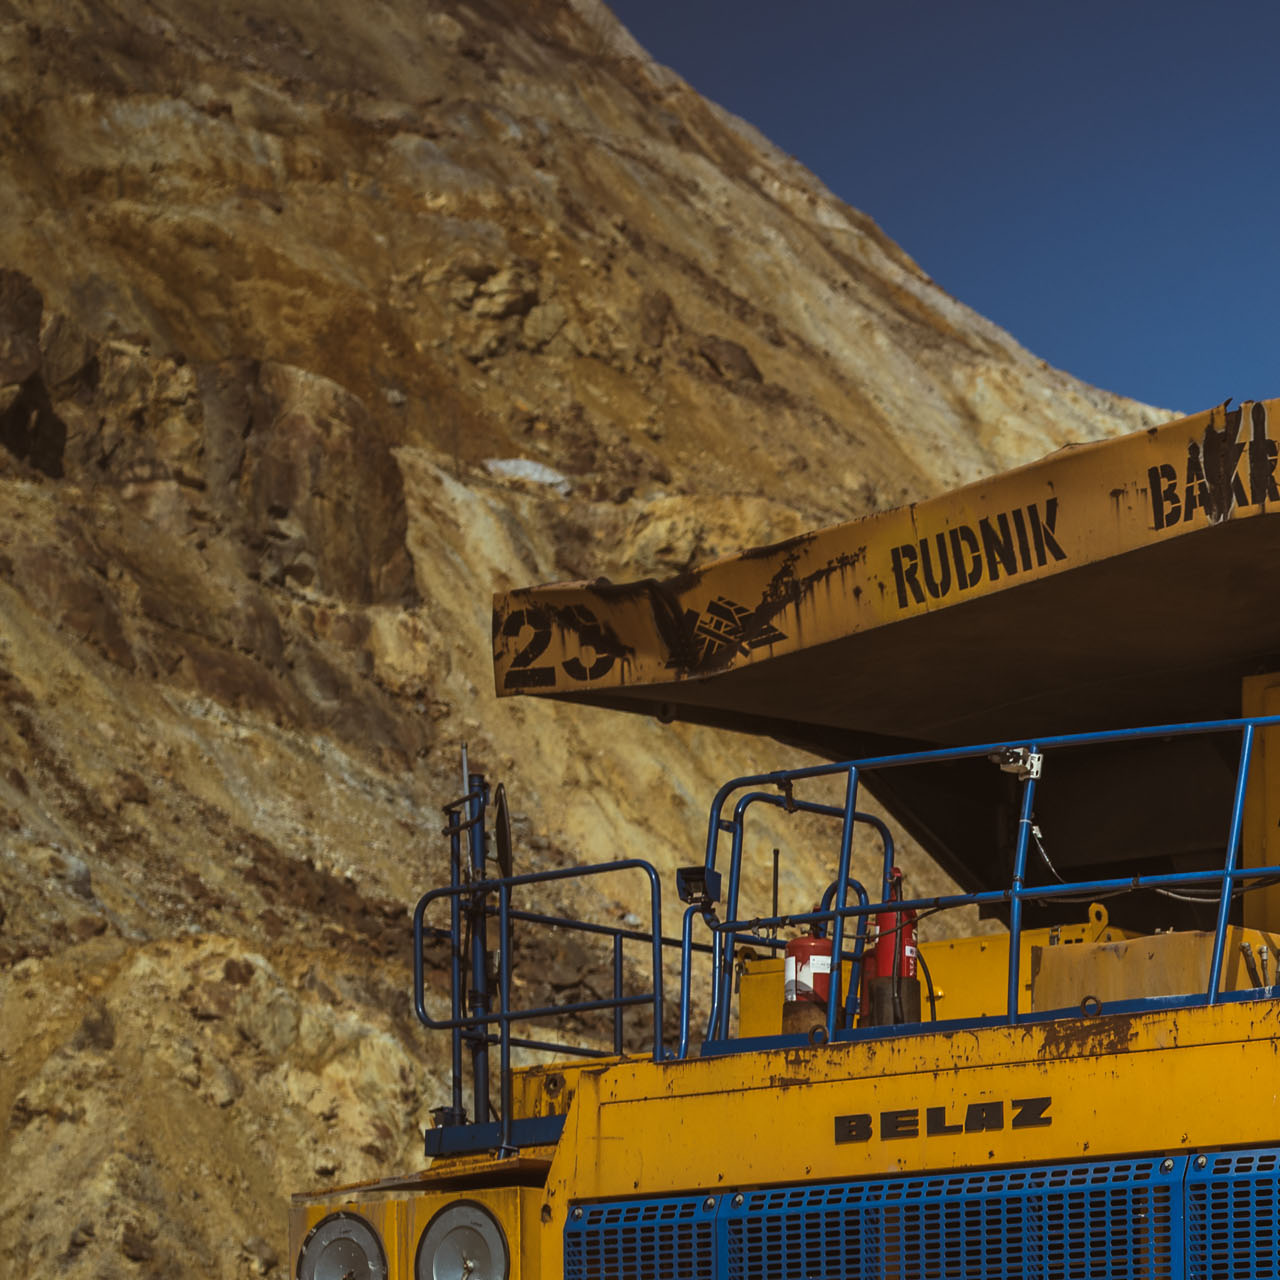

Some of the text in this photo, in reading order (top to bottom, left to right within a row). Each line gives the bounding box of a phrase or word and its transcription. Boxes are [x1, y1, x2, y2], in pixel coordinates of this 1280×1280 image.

[891, 497, 1068, 609] RUDNIK
[502, 604, 617, 689] 23
[834, 1096, 1053, 1145] BELAZ
